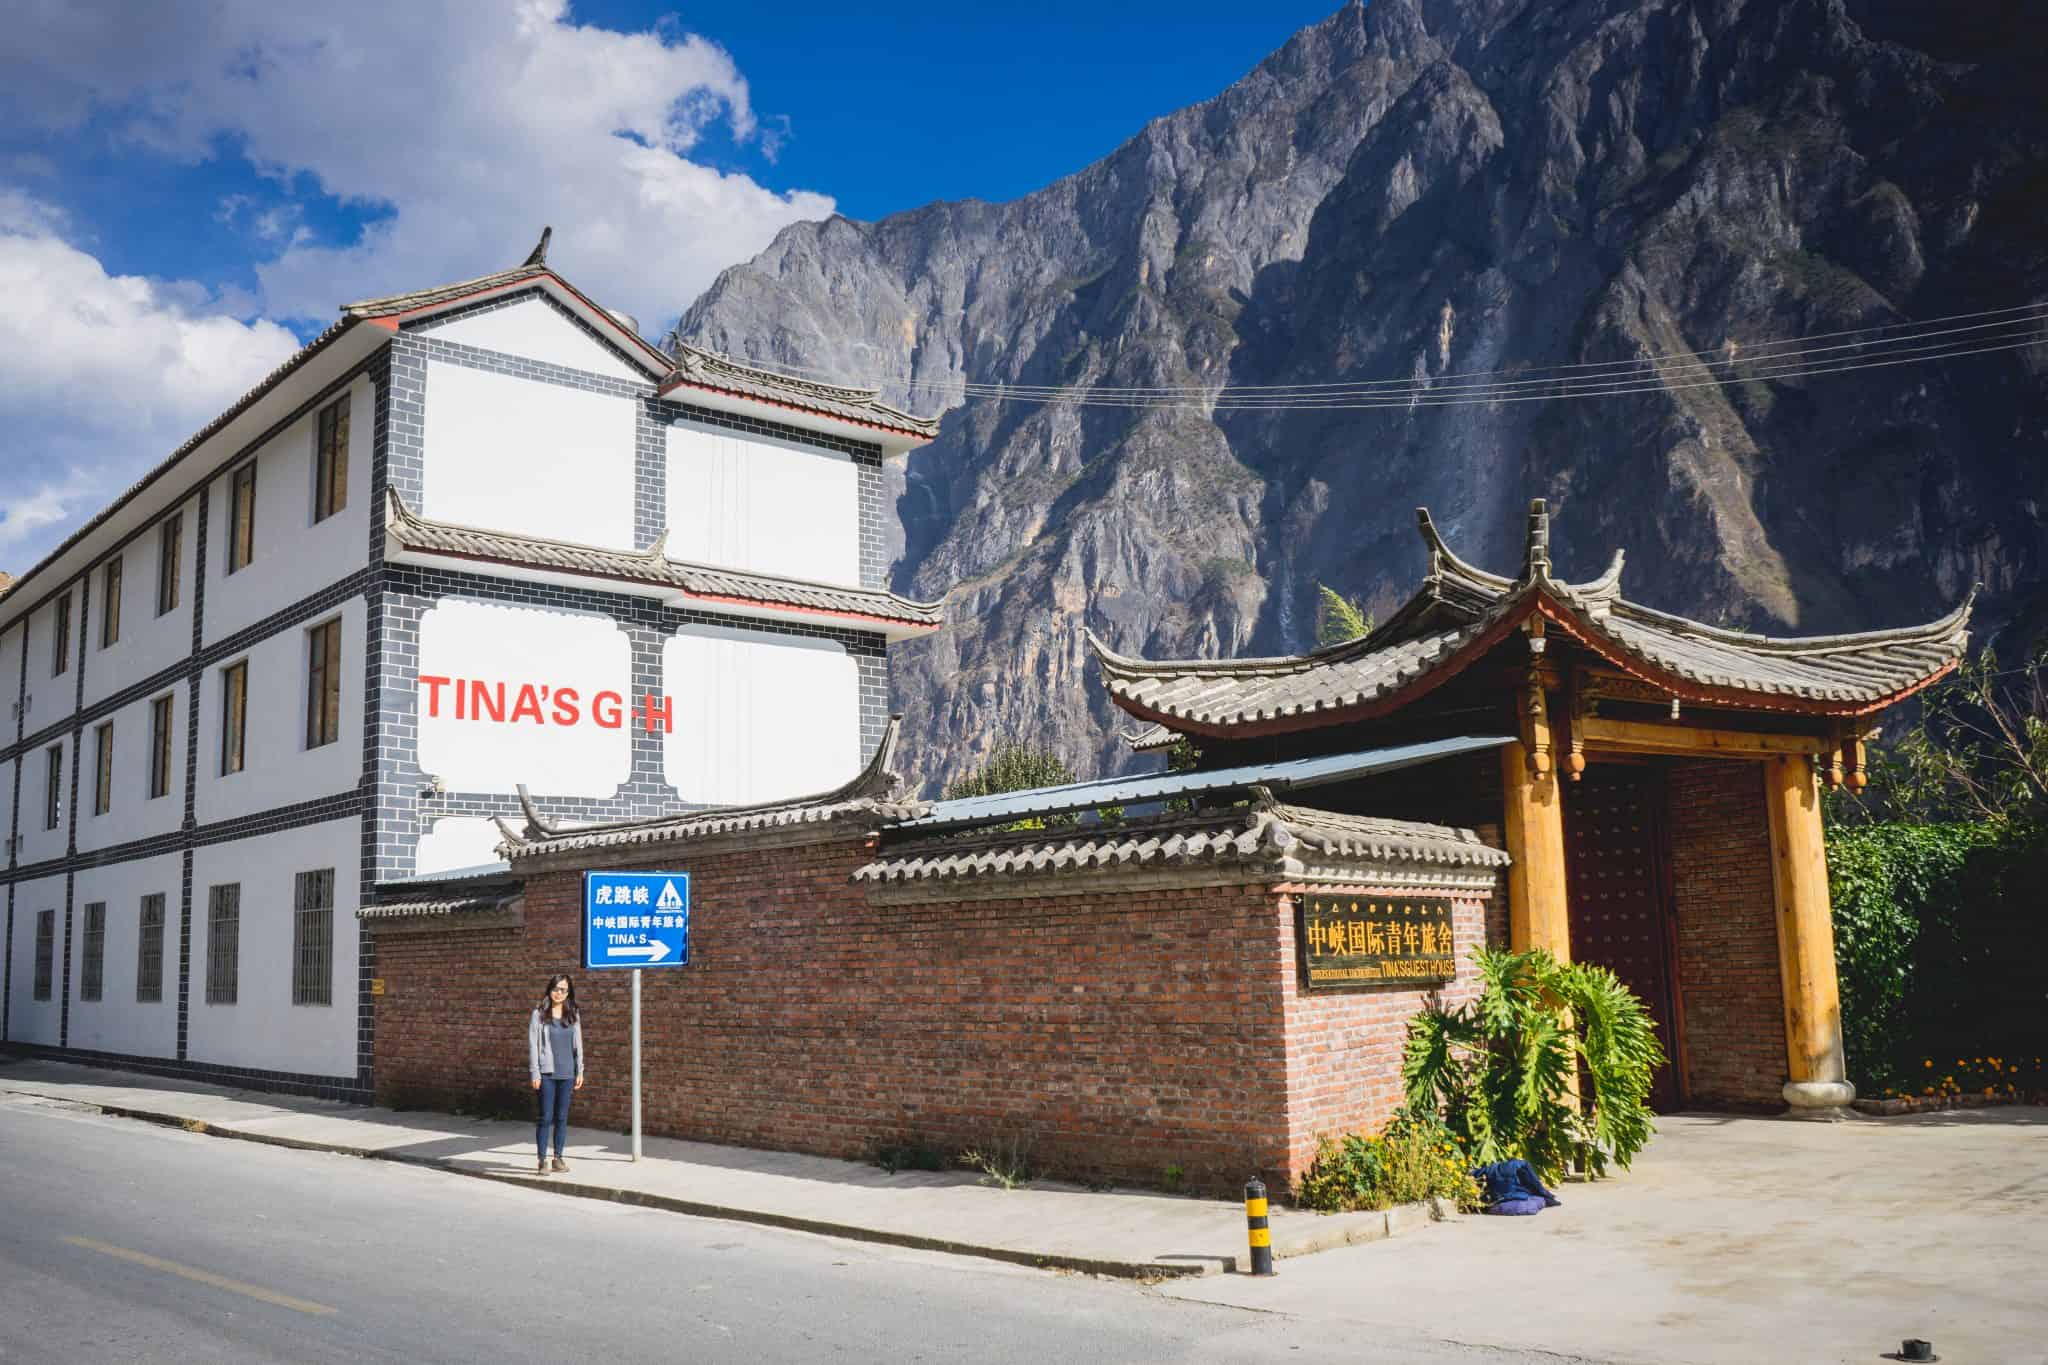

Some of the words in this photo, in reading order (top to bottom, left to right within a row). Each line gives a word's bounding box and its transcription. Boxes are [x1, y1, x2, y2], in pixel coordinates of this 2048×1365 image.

[418, 675, 580, 727] TINA'S
[595, 885, 649, 905] 虎跳峡
[1308, 919, 1453, 957] 中峡国际青年旅舍
[1430, 960, 1455, 976] HOUSE
